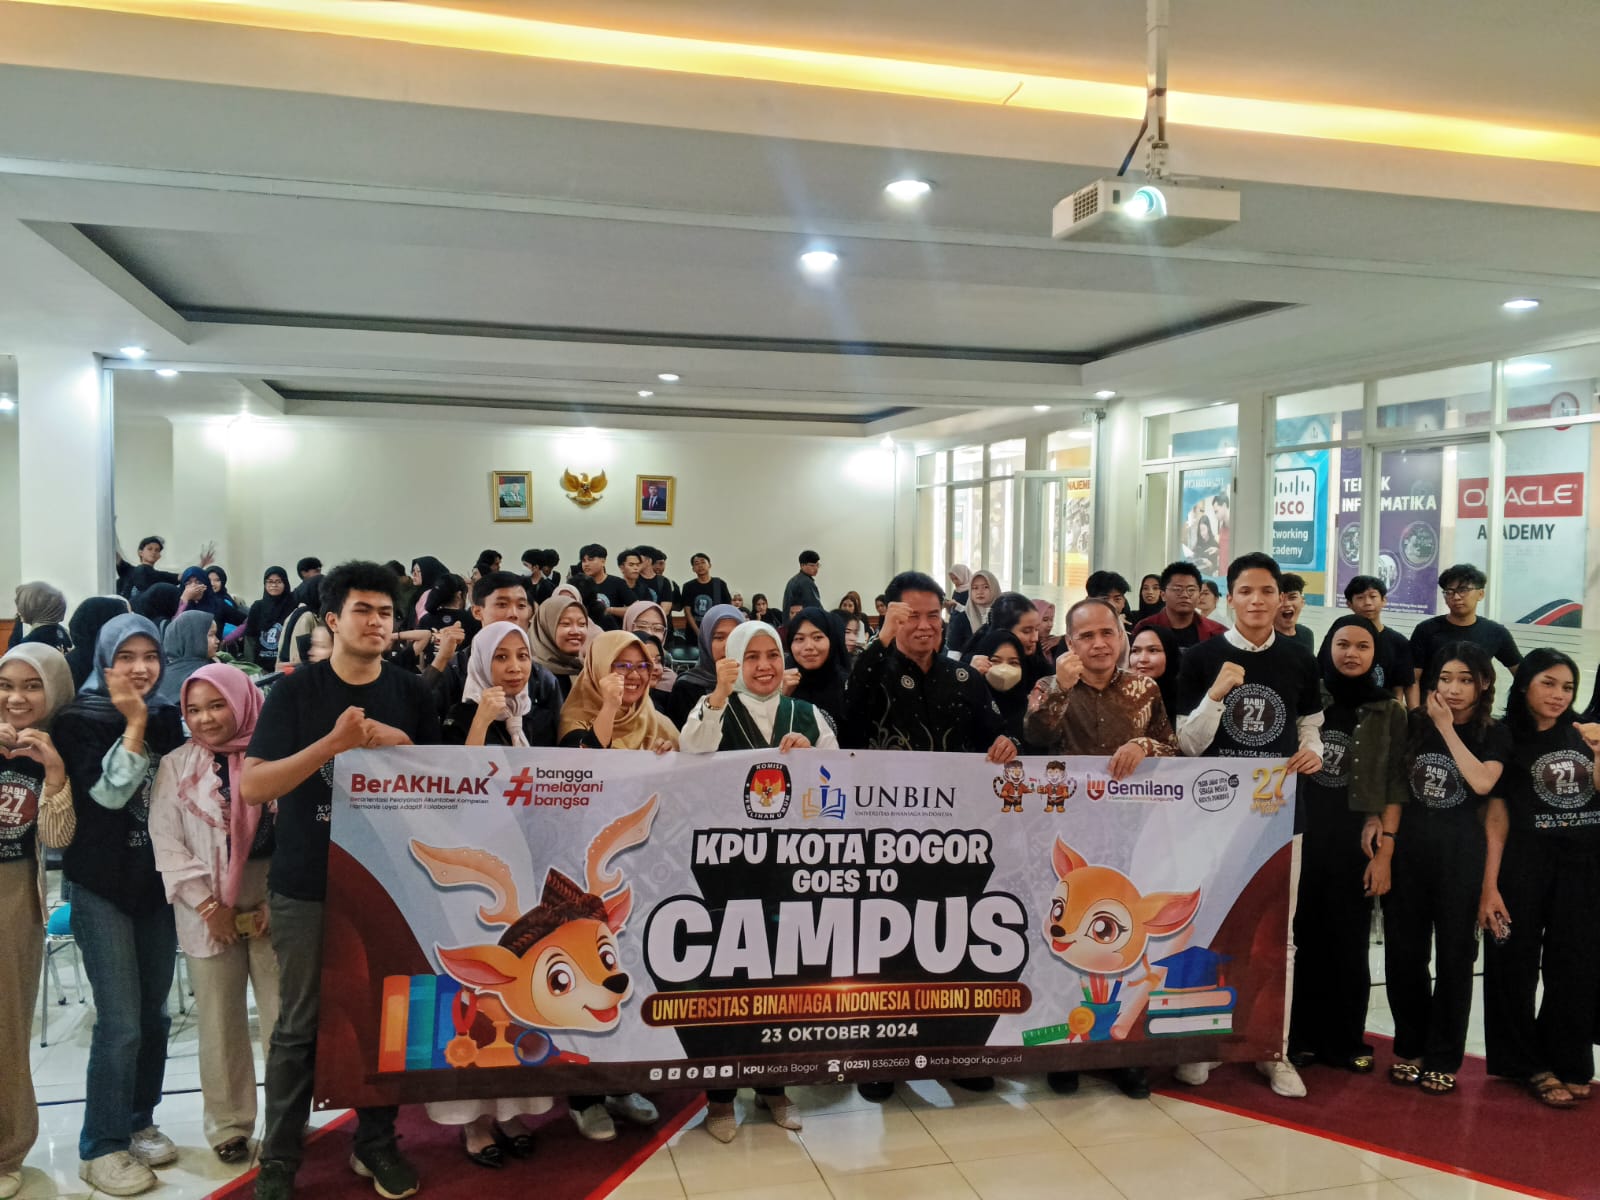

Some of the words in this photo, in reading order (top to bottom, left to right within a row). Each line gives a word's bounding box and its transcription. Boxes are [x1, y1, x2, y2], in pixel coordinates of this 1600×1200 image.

[1342, 495, 1437, 512] INFMATIKA
[1464, 484, 1573, 507] OACLE
[1275, 501, 1304, 515] ISCO
[1243, 698, 1265, 706] RABU
[1243, 705, 1265, 721] 27
[1426, 765, 1448, 777] RABU
[1549, 760, 1574, 770] RABU
[536, 767, 593, 782] bangga
[1252, 765, 1289, 800] 27
[1425, 773, 1447, 788] 27
[1552, 767, 1575, 783] 27
[2, 785, 27, 796] RABU
[351, 773, 490, 795] BerAKHLAK
[535, 781, 604, 796] melayani
[1107, 780, 1184, 800] Gemilang
[0, 793, 26, 813] 27
[534, 794, 590, 809] bangsa
[854, 785, 956, 809] UNBIN
[696, 832, 767, 865] KPU
[776, 833, 865, 865] KOTA
[874, 834, 988, 864] BOGOR
[792, 869, 860, 893] GOES
[866, 869, 898, 892] TO
[648, 896, 1025, 983] CAMPUS
[652, 996, 749, 1021] UNIVERSITAS
[753, 993, 832, 1015] BINANIAGA
[836, 990, 910, 1012] INDONESIA
[915, 988, 970, 1010] (UNBIN)
[975, 988, 1021, 1009] BOGOR
[761, 1027, 782, 1043] 23
[789, 1025, 870, 1042] OKTOBER
[876, 1023, 919, 1038] 2024
[743, 1066, 764, 1075] KPU
[767, 1065, 788, 1073] Kota
[791, 1063, 819, 1075] Bogor
[843, 1059, 870, 1070] (0251)
[872, 1058, 910, 1068] 8362669
